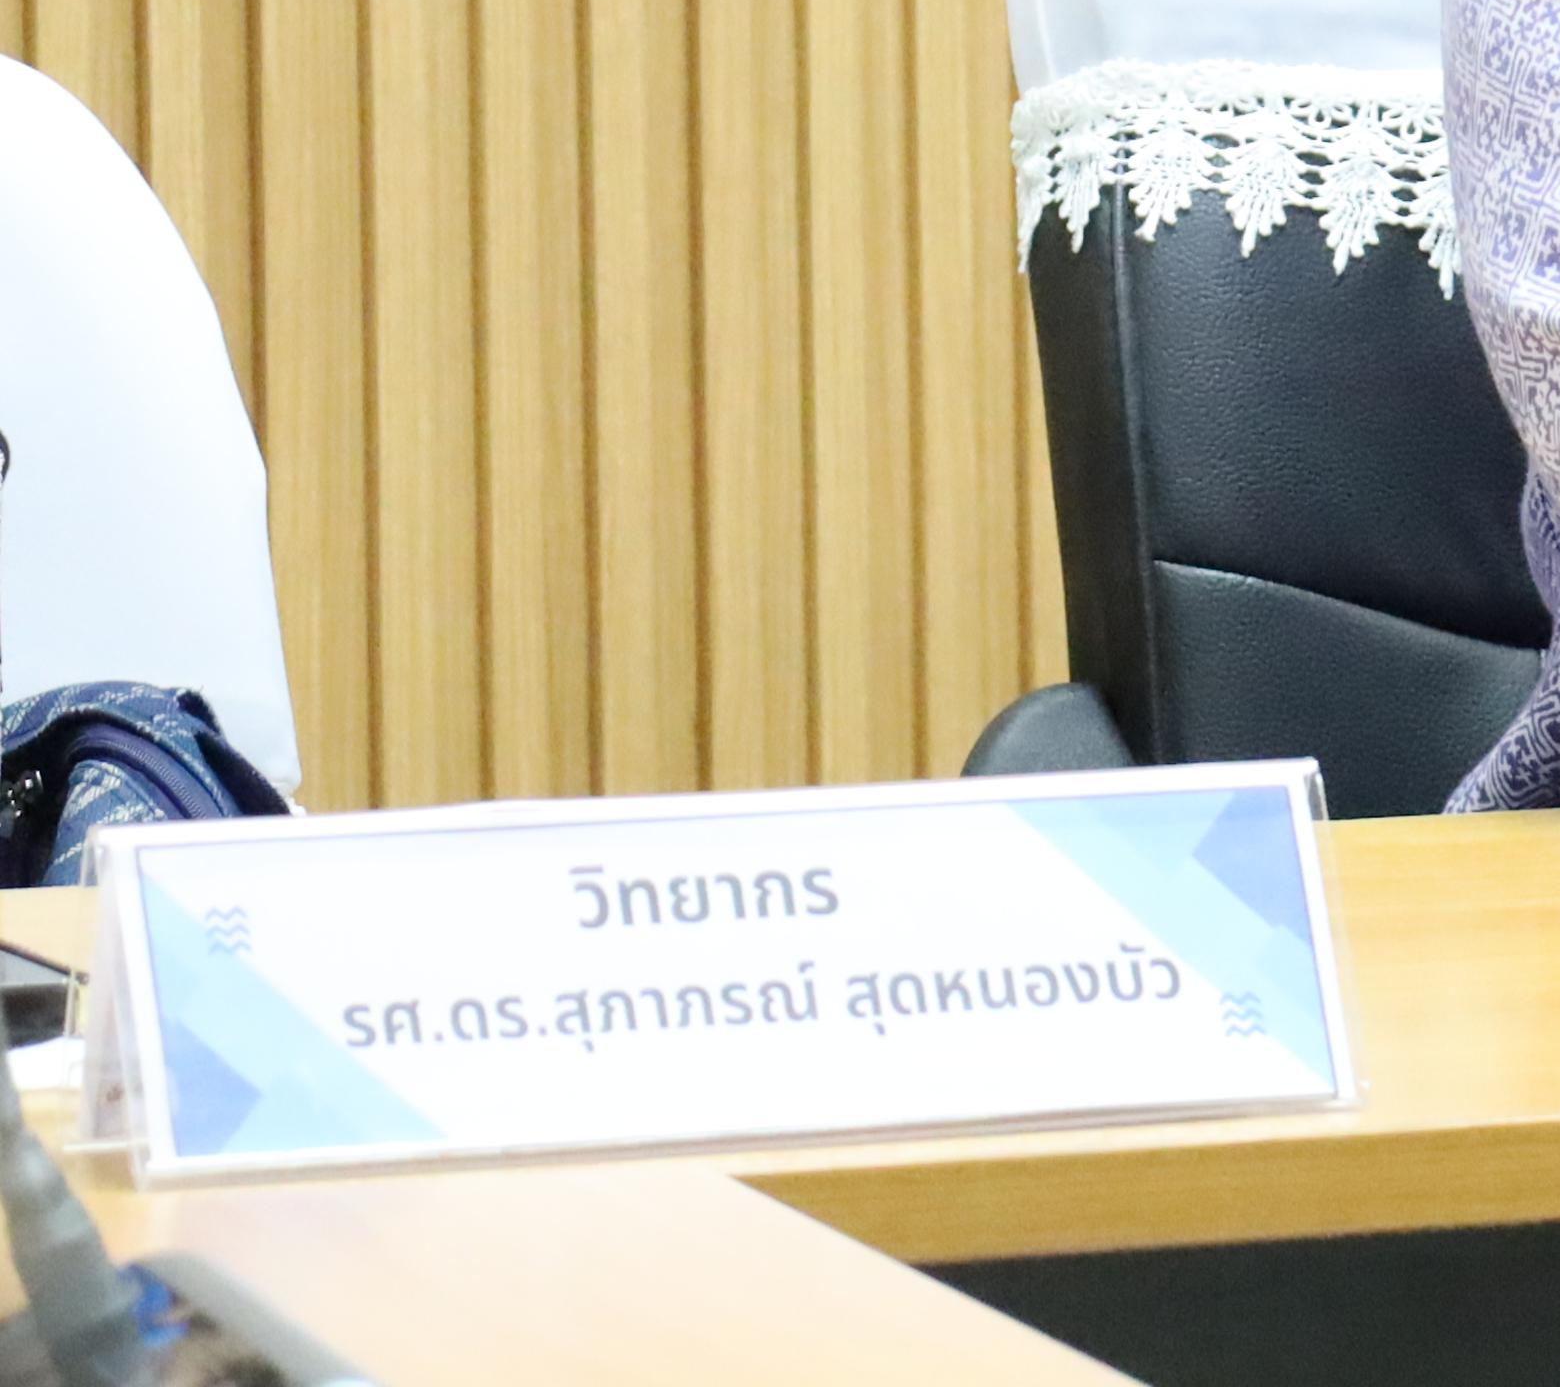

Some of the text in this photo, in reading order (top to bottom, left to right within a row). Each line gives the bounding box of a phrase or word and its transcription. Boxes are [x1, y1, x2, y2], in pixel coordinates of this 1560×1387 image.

[567, 864, 840, 930] วิทยากร
[342, 941, 1182, 1053] รศ.ดร.สุภาภรณ์ สุดหนองบัว
